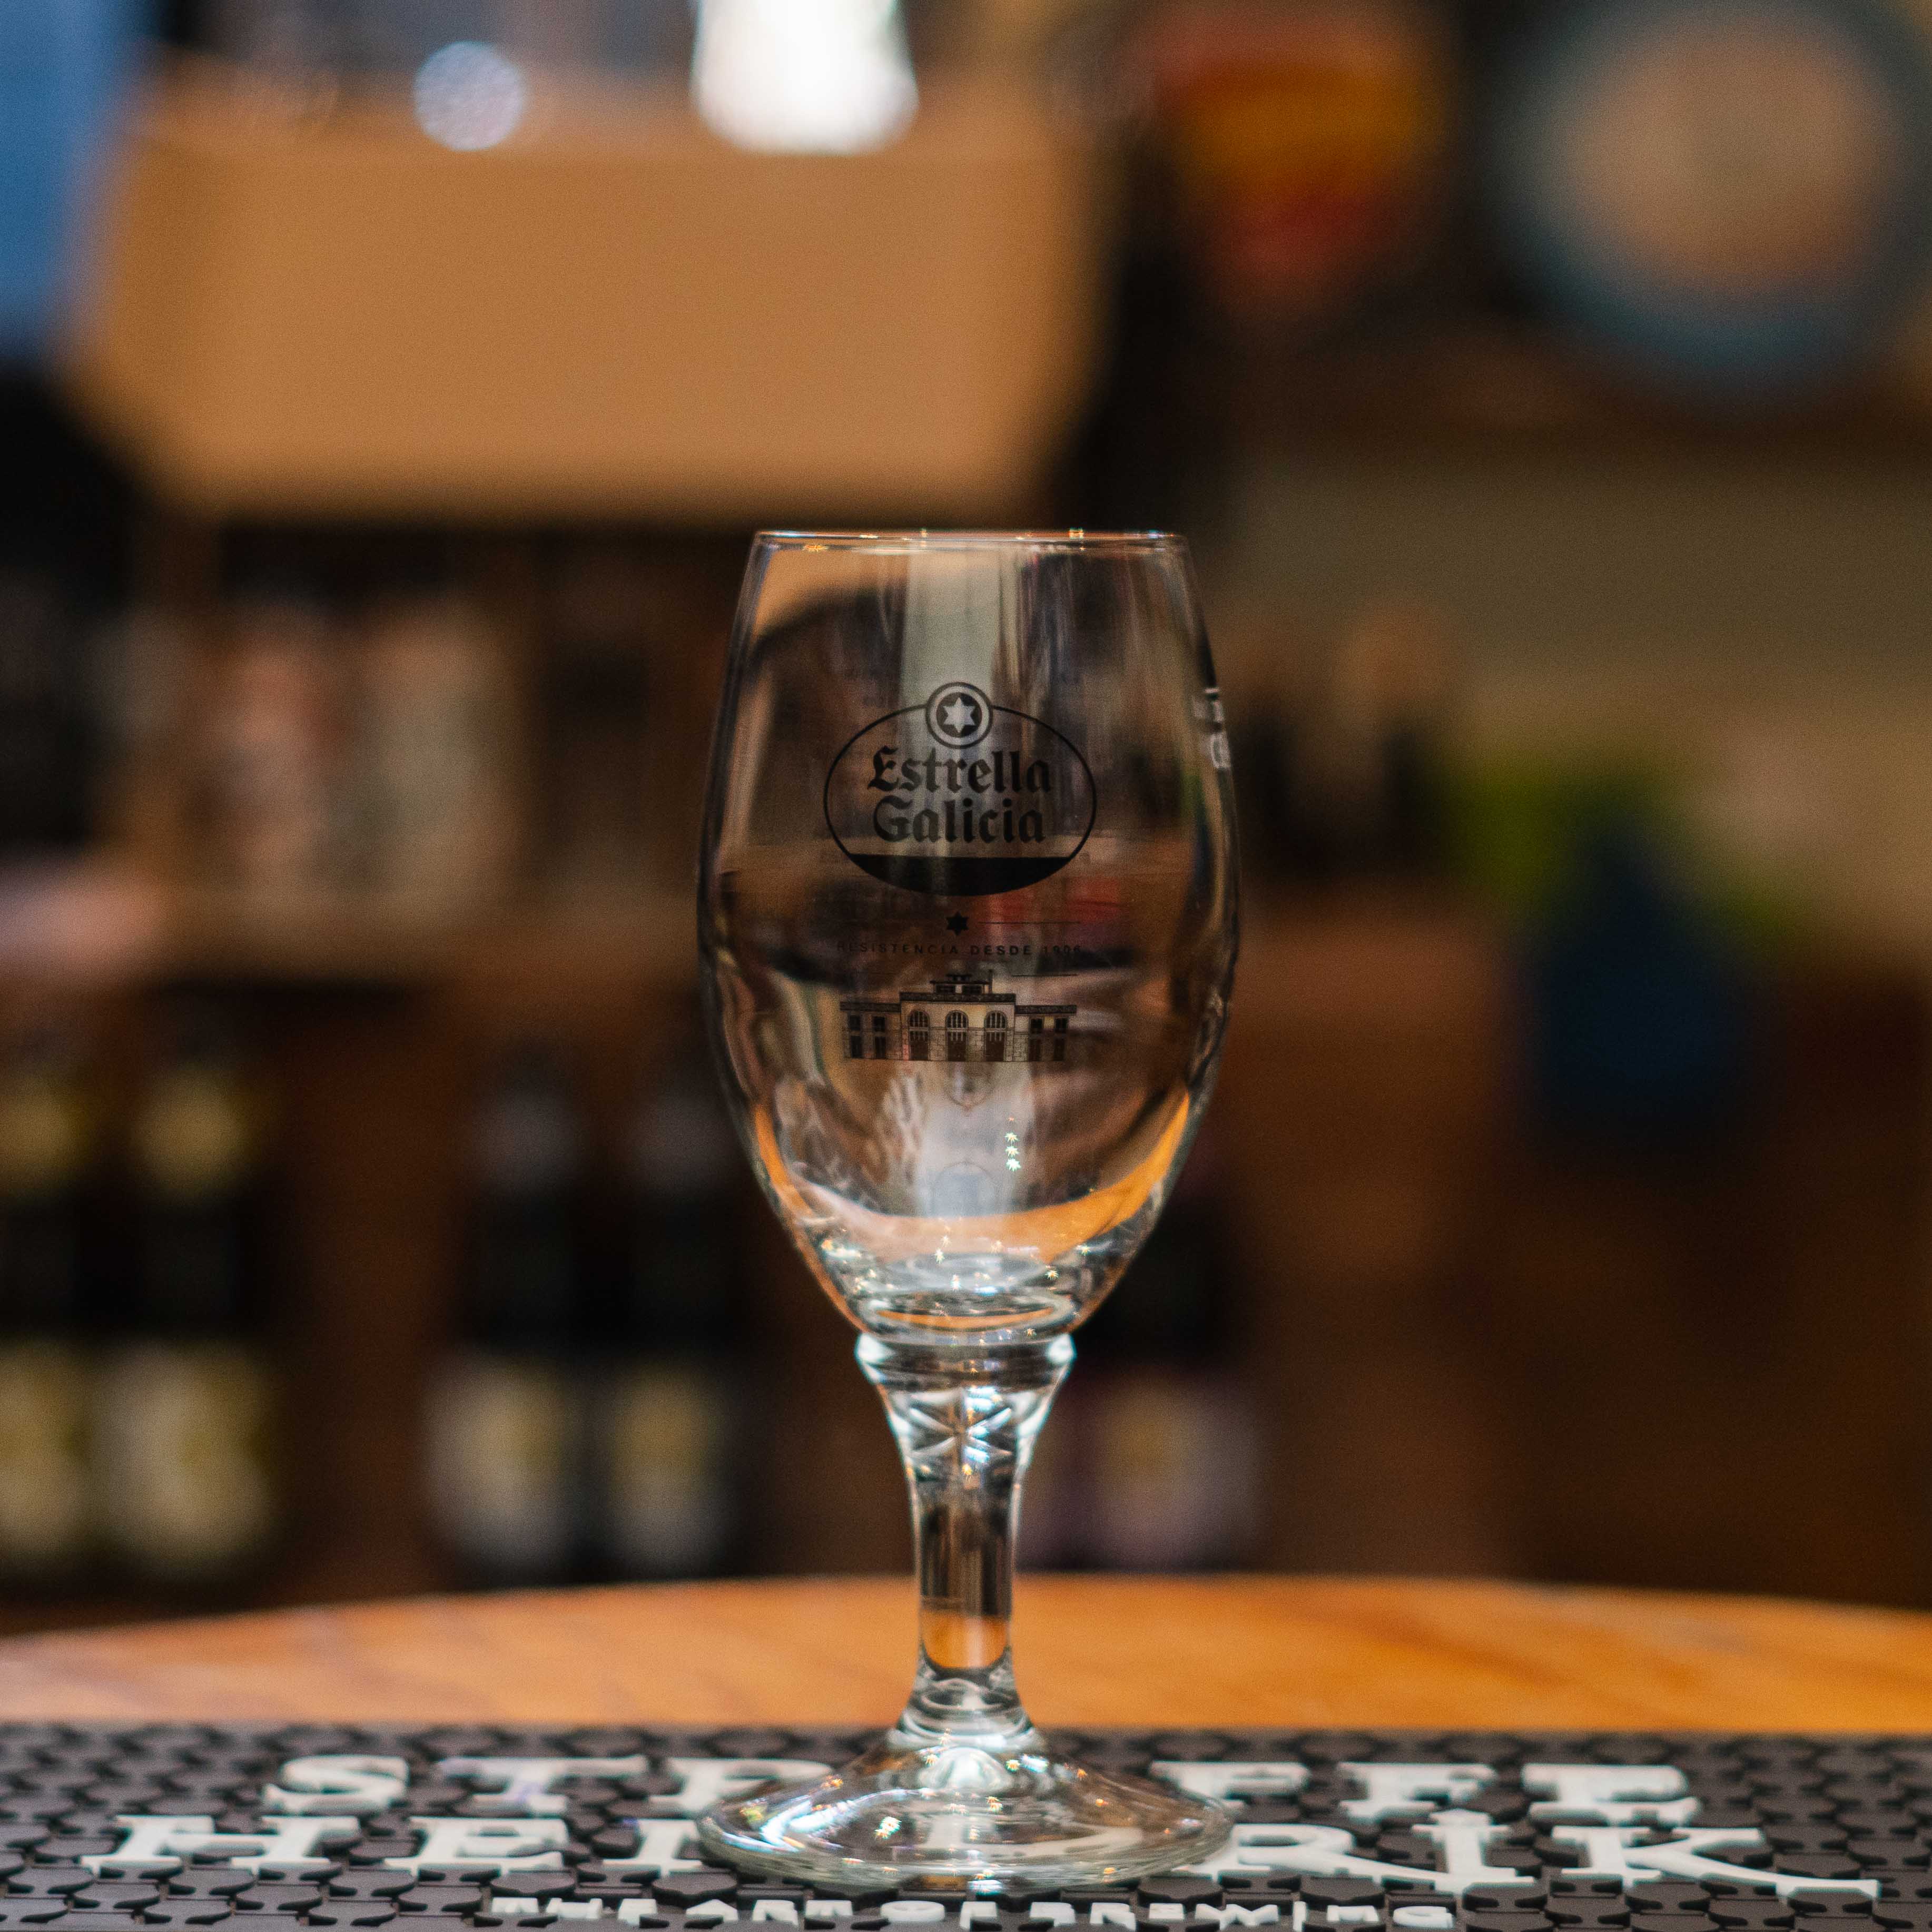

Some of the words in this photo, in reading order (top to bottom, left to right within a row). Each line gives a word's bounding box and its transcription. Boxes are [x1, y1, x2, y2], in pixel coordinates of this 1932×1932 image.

[867, 745, 1052, 793] Estrella
[873, 795, 1046, 843] Galicia
[970, 944, 1031, 955] DESDE
